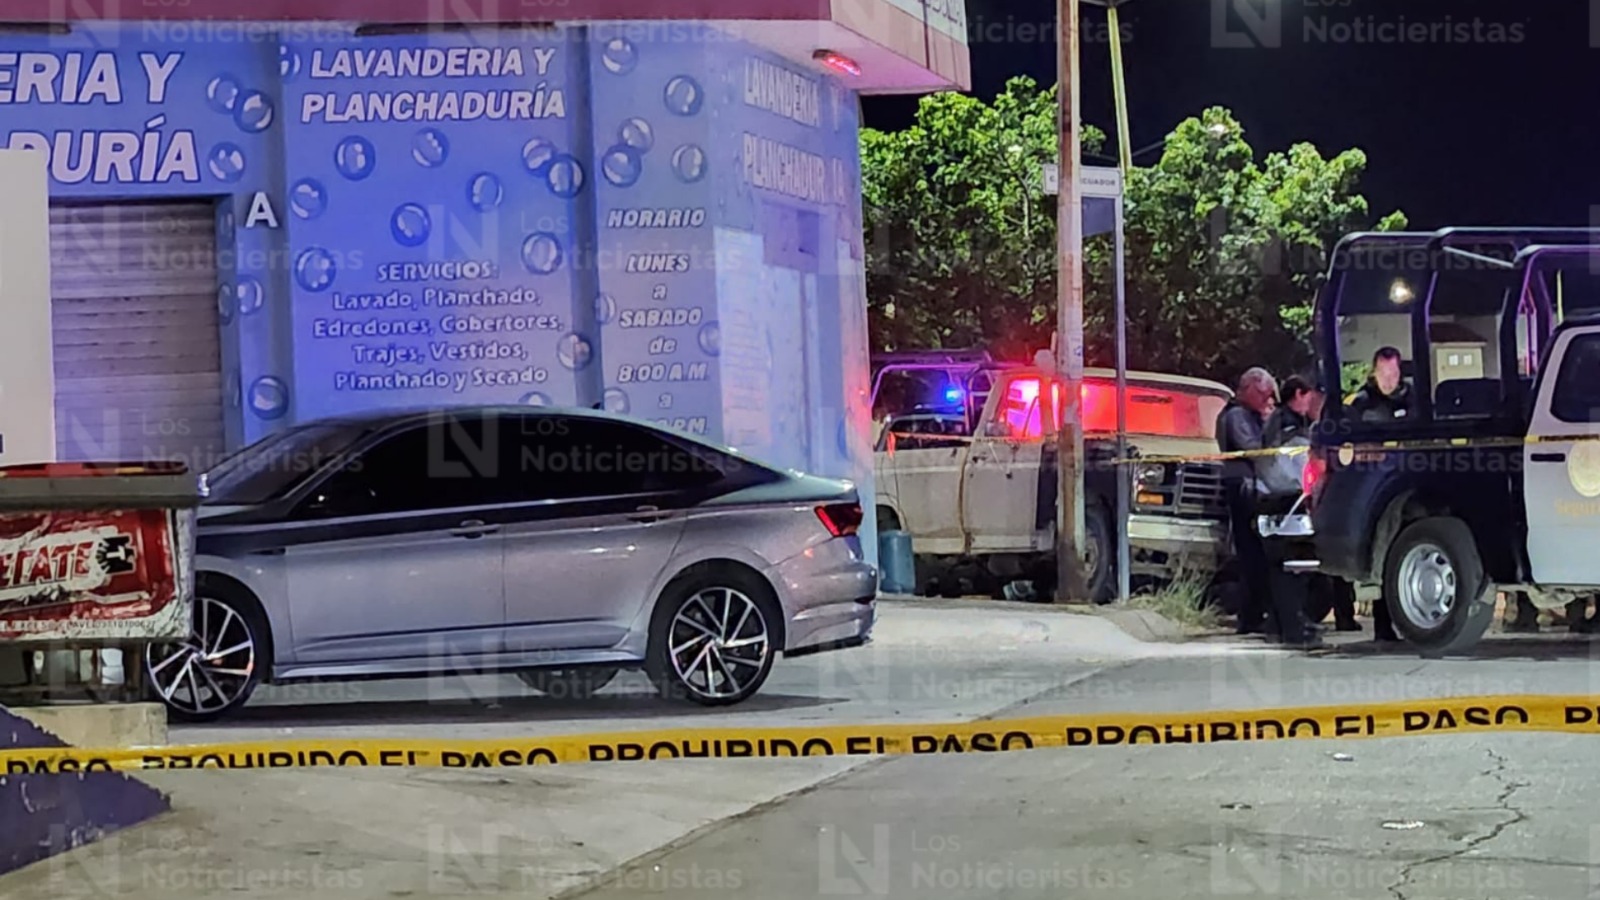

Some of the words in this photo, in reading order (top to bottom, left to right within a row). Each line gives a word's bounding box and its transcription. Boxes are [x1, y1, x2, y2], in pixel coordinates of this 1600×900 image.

[311, 48, 523, 78] LAVANDERIA
[533, 48, 556, 76] Y
[140, 53, 182, 103] Y
[301, 82, 566, 123] PLANCHADURÍA
[1080, 177, 1115, 186] CUADOR
[248, 192, 278, 228] A
[608, 208, 706, 229] HORARIO
[626, 253, 690, 274] LUNES
[332, 290, 418, 311] Lavado,
[424, 286, 543, 306] Planchado,
[652, 285, 667, 299] a
[313, 317, 434, 338] Edredones,
[440, 313, 564, 334] Cobertores,
[619, 307, 702, 328] SABADO
[431, 341, 528, 361] Vestidos,
[649, 337, 677, 355] de
[335, 370, 449, 390] Planchado
[455, 377, 468, 393] y
[472, 366, 548, 387] Secado
